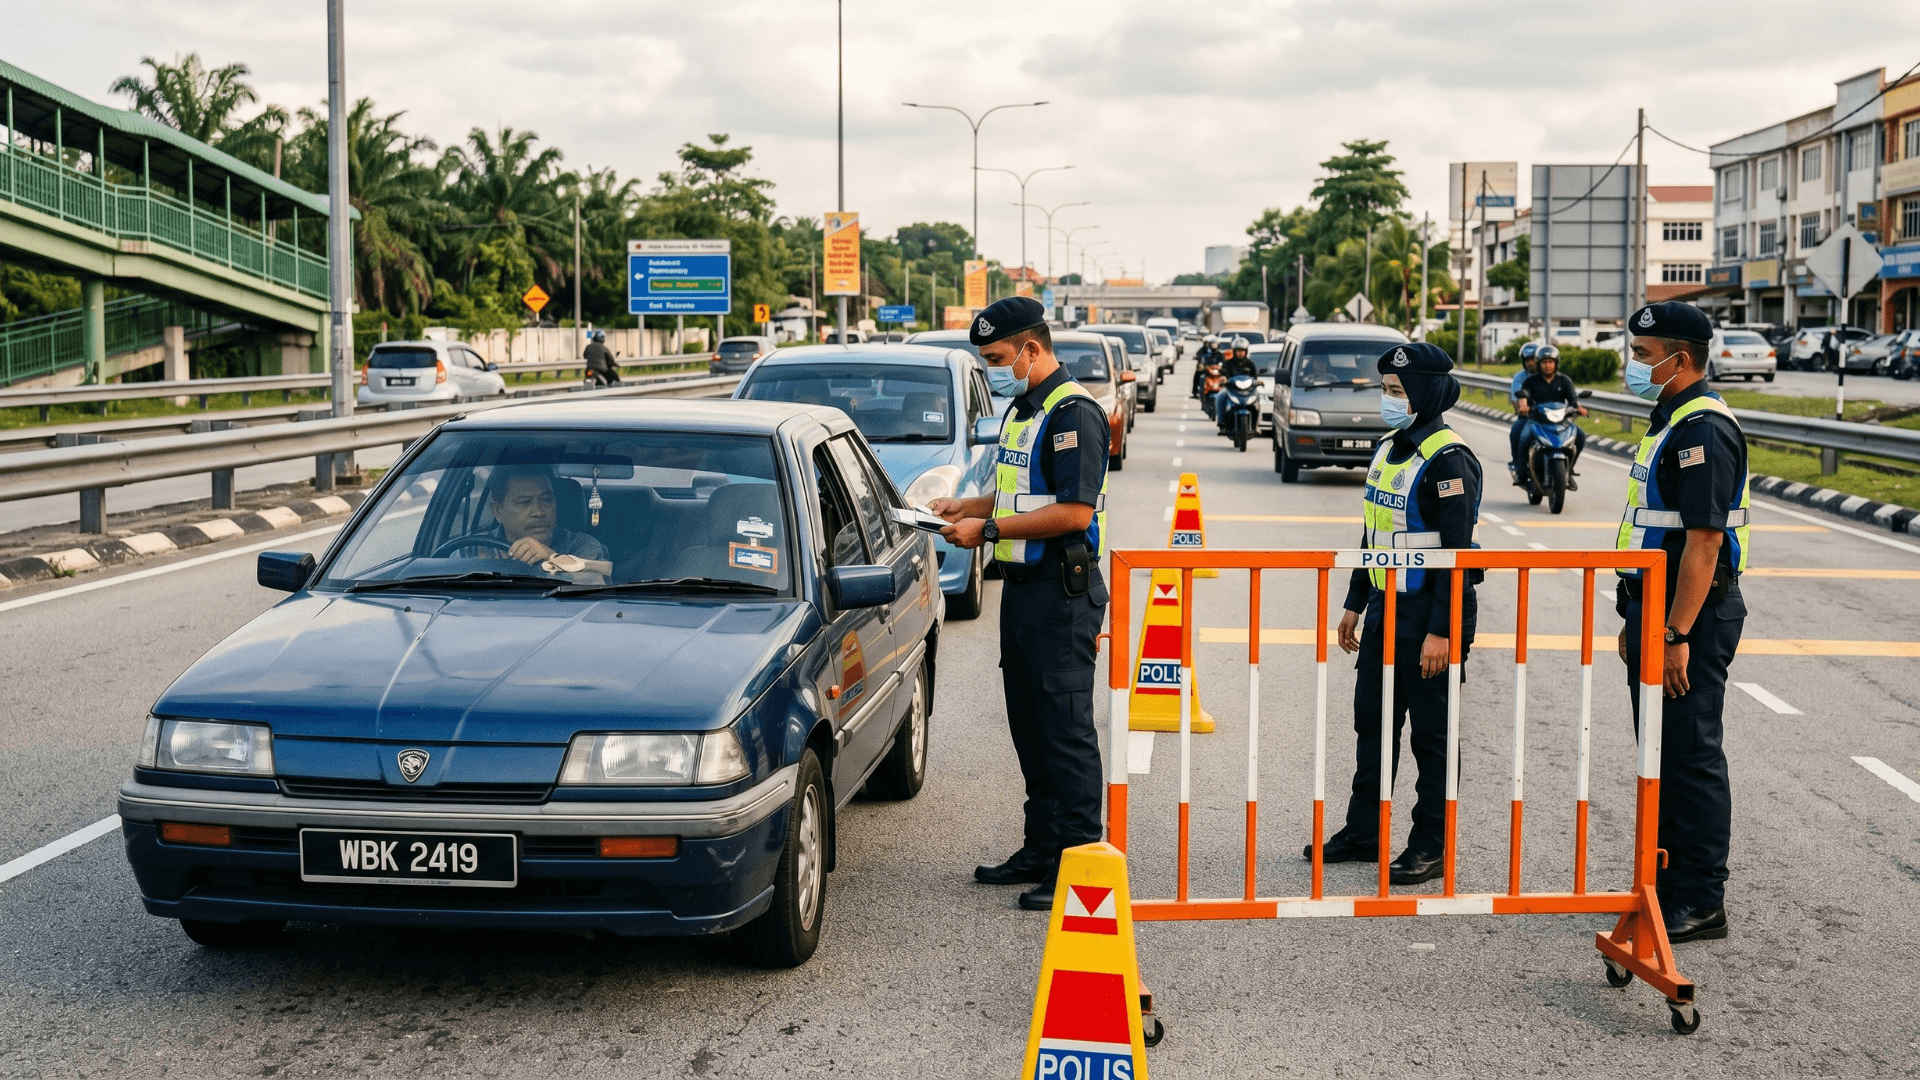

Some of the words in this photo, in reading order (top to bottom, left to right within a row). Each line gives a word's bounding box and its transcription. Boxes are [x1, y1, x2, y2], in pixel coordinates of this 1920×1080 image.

[1003, 451, 1027, 466] POLIS
[1377, 492, 1404, 508] POLIS
[1172, 533, 1202, 545] POLIS
[1362, 552, 1425, 566] POLIS
[339, 839, 400, 872] WBK
[410, 841, 478, 874] 2419
[1038, 1053, 1132, 1080] POLIS
